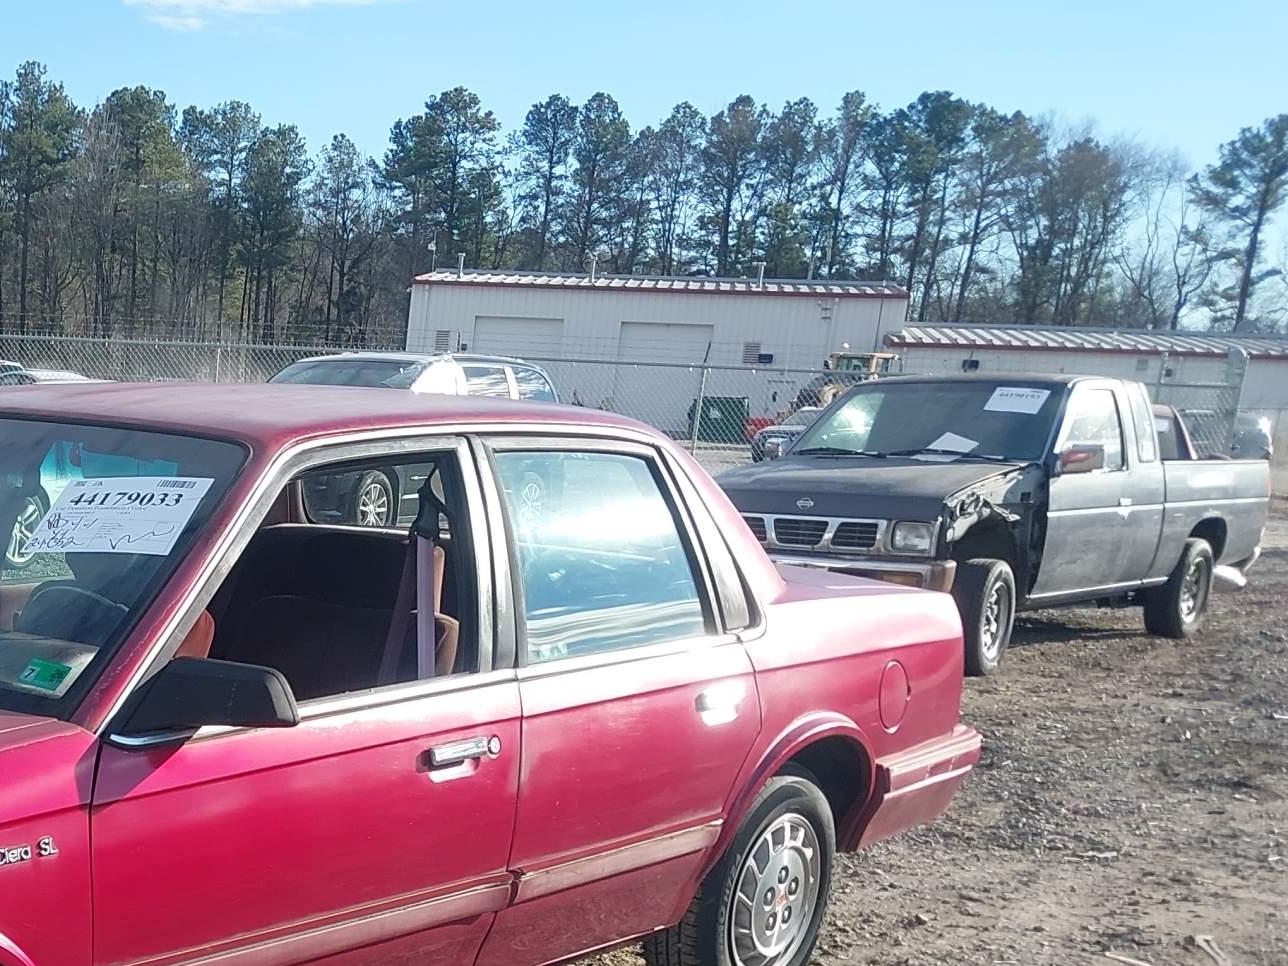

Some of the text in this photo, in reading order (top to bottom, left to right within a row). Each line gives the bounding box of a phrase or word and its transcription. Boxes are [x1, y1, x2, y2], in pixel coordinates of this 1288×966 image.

[69, 491, 184, 508] 44179033
[23, 667, 36, 679] 7
[39, 837, 59, 856] SL
